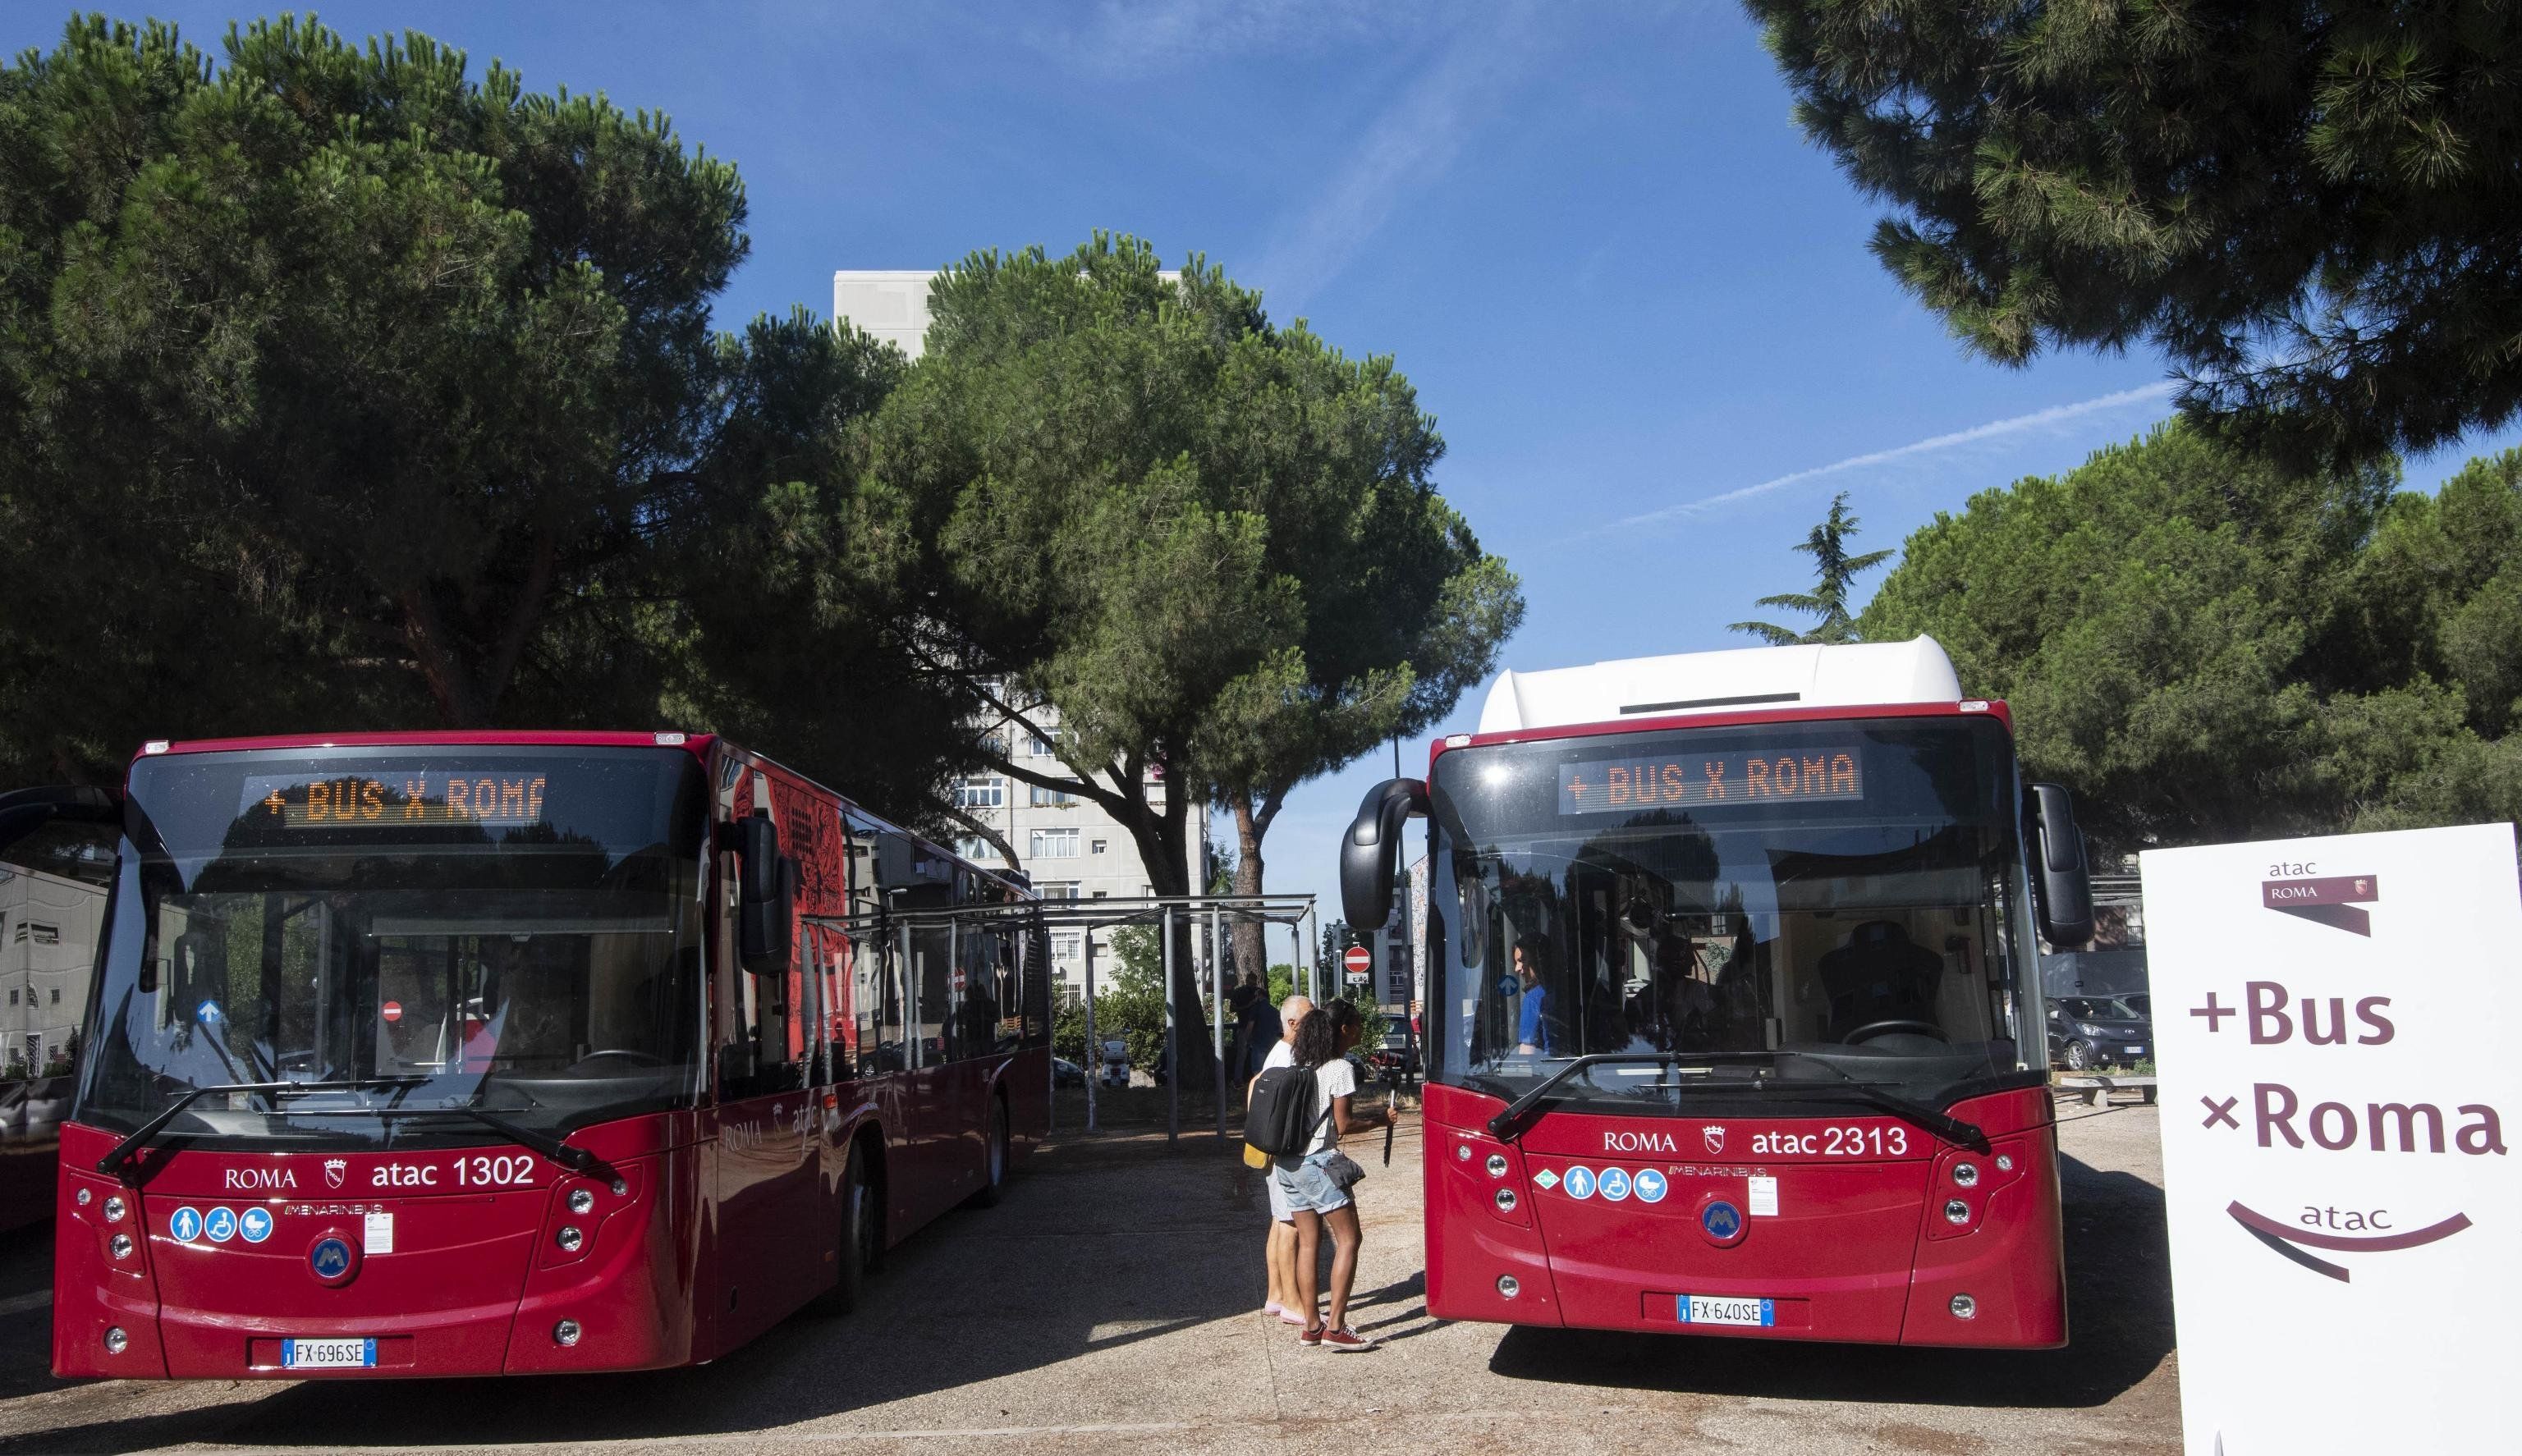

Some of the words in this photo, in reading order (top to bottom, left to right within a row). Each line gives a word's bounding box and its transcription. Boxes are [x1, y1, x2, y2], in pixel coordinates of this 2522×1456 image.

[1608, 764, 1683, 804] BUS
[1705, 762, 1725, 799] X
[1747, 754, 1857, 797] ROMA
[308, 781, 384, 820] BUS
[406, 780, 426, 819] X
[2269, 862, 2317, 877] atac
[2272, 886, 2318, 900] ROMA
[726, 1119, 762, 1153] ROMA
[1604, 1133, 1677, 1152] ROMA
[1752, 1133, 1817, 1154] atac
[1824, 1127, 1908, 1156] 2313
[225, 1169, 297, 1188] ROMA
[372, 1162, 438, 1187] atac
[453, 1156, 534, 1185] 1302
[2300, 1206, 2392, 1231] atac
